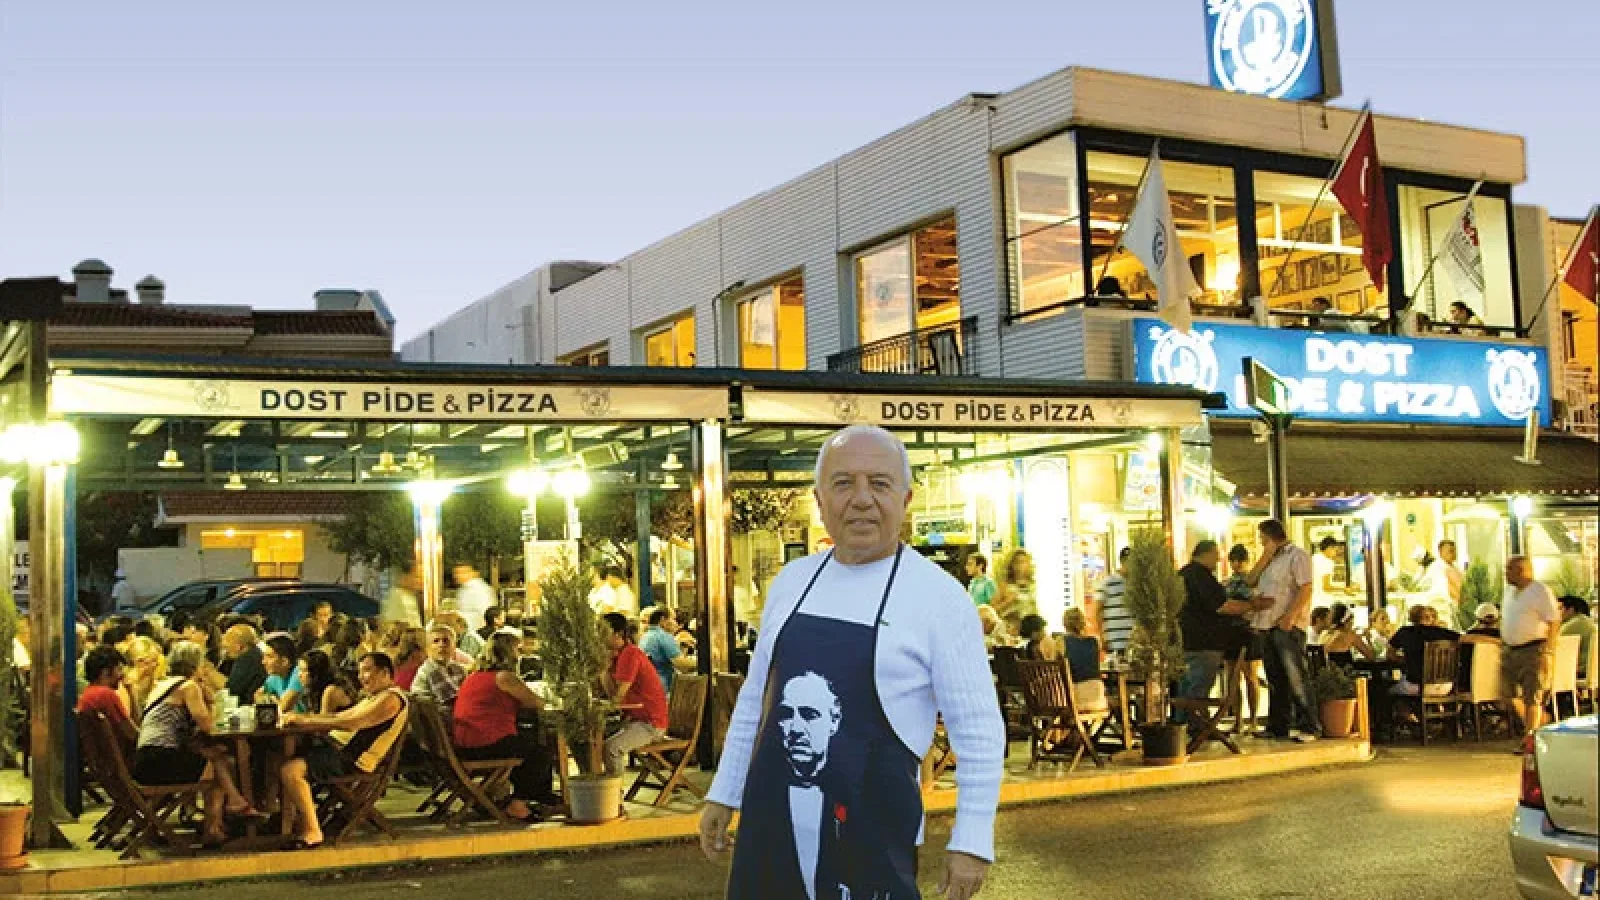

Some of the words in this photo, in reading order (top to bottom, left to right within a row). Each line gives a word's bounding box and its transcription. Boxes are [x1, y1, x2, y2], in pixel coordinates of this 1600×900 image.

[1305, 337, 1414, 376] DOST
[260, 389, 347, 411] DOST
[362, 387, 434, 412] PİDE
[442, 394, 460, 414] &
[467, 388, 558, 413] PİZZA
[881, 402, 944, 420] DOST
[955, 400, 1006, 420] PİDE
[1012, 406, 1025, 422] &
[1029, 400, 1095, 420] PİZZA
[1337, 379, 1365, 413] &
